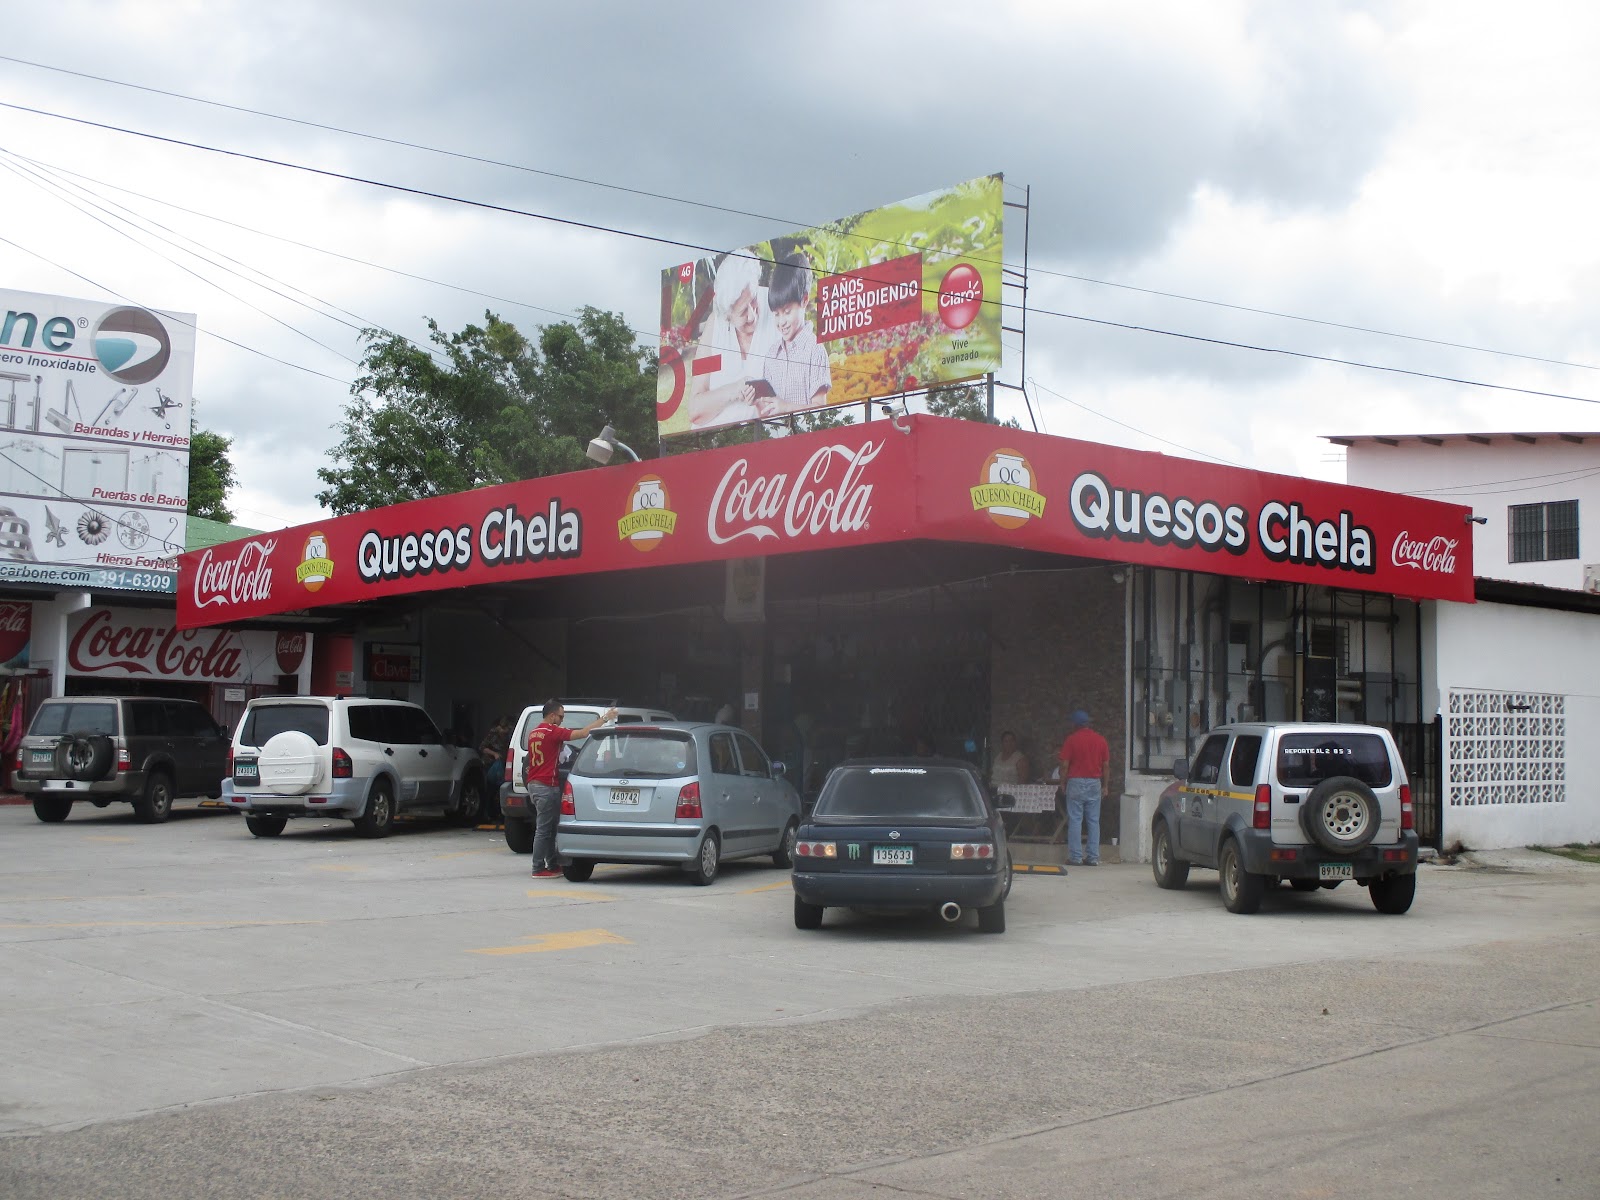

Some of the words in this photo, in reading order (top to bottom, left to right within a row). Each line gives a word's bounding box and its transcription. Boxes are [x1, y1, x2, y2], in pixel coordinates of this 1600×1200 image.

[681, 266, 691, 278] 4G
[821, 279, 918, 319] APRENDIENDO
[822, 286, 829, 301] 5
[831, 277, 864, 300] AÑOS
[940, 286, 977, 308] Claro
[821, 309, 873, 336] JUNTOS
[951, 338, 969, 351] Vive
[27, 354, 97, 374] Inoxidable
[941, 349, 979, 365] avanzado
[73, 422, 130, 440] Barandas
[132, 428, 140, 441] y
[141, 430, 190, 447] Herrajes
[999, 466, 1021, 486] QC
[91, 487, 137, 502] Puertas
[139, 491, 155, 504] de
[156, 492, 188, 507] Baño
[640, 491, 658, 510] QC
[973, 487, 1011, 507] QUESOS
[1011, 490, 1043, 514] CHELA
[620, 512, 649, 536] QUESOS
[649, 513, 674, 532] CHELA
[1069, 472, 1247, 548] Quesos
[1258, 501, 1372, 568] Chela
[357, 525, 472, 580] Quesos
[479, 500, 580, 561] Chela
[96, 552, 133, 566] Hierro
[97, 570, 171, 589] 391-6309
[530, 740, 545, 767] 15
[876, 849, 911, 860] 135633
[1321, 866, 1351, 876] 891742
